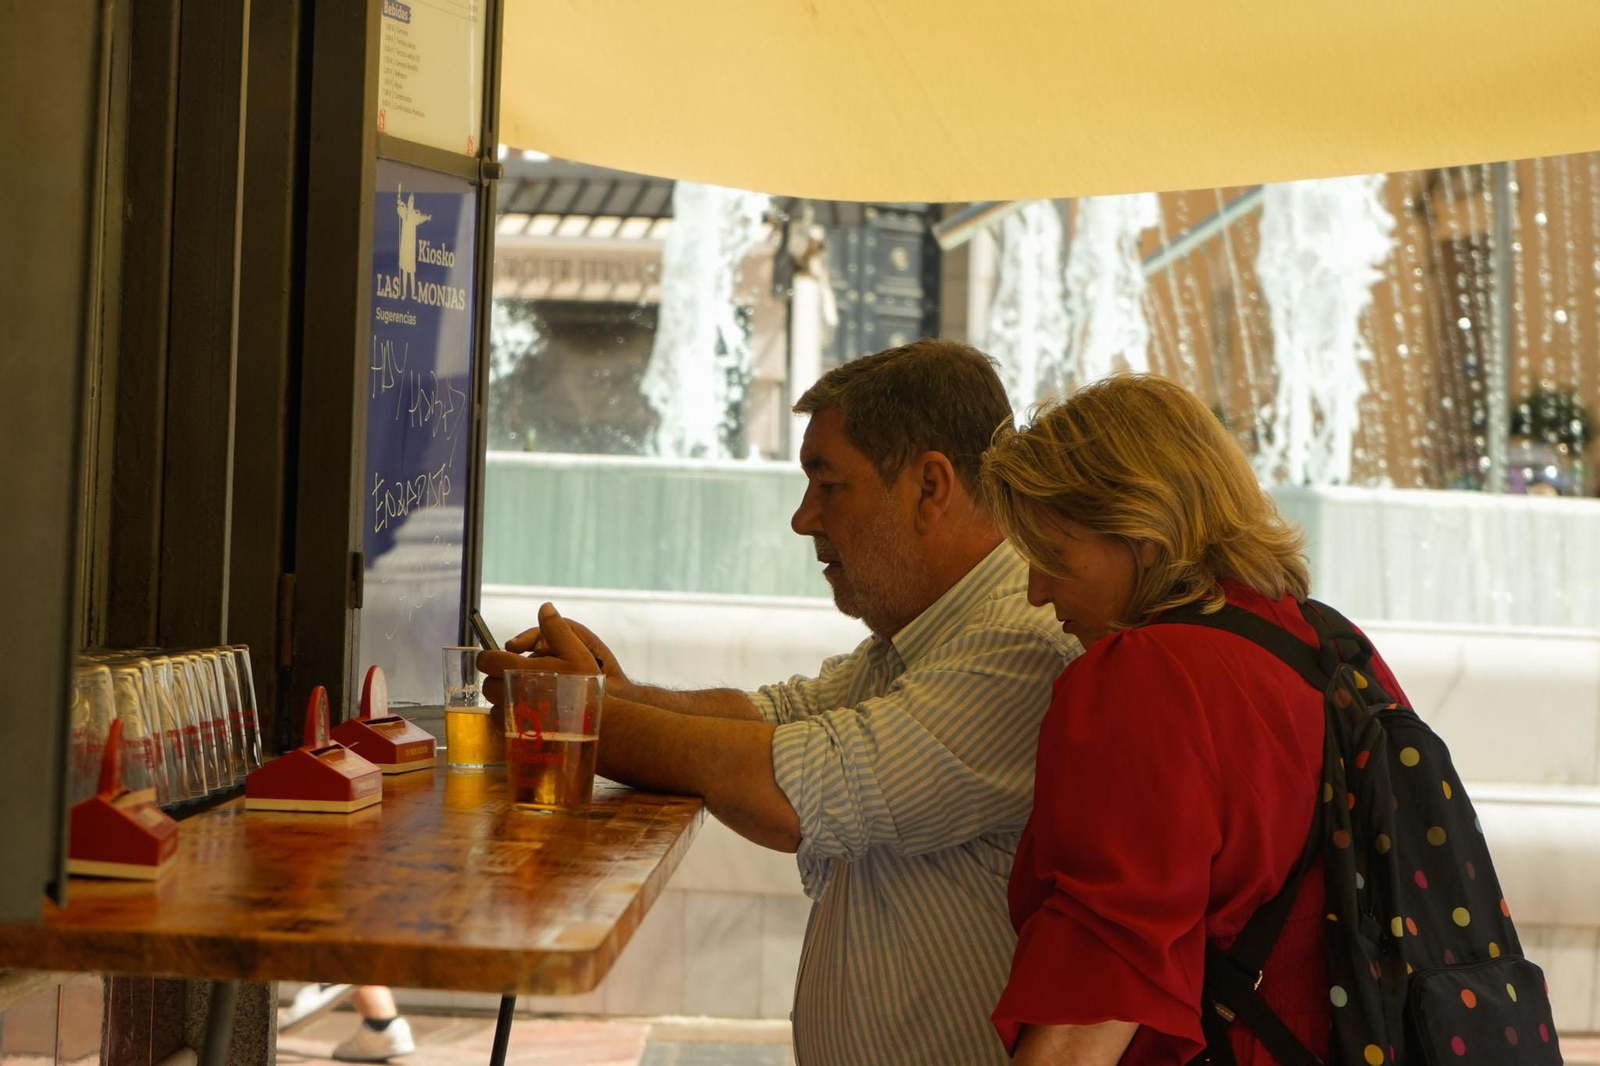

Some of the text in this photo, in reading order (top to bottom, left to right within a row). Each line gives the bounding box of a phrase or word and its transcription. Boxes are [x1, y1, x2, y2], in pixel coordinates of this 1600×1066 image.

[384, 1, 408, 20] Bebidas
[418, 239, 455, 268] Kiosko
[376, 273, 466, 311] LAS MONJAS
[375, 306, 417, 326] Sugerencias
